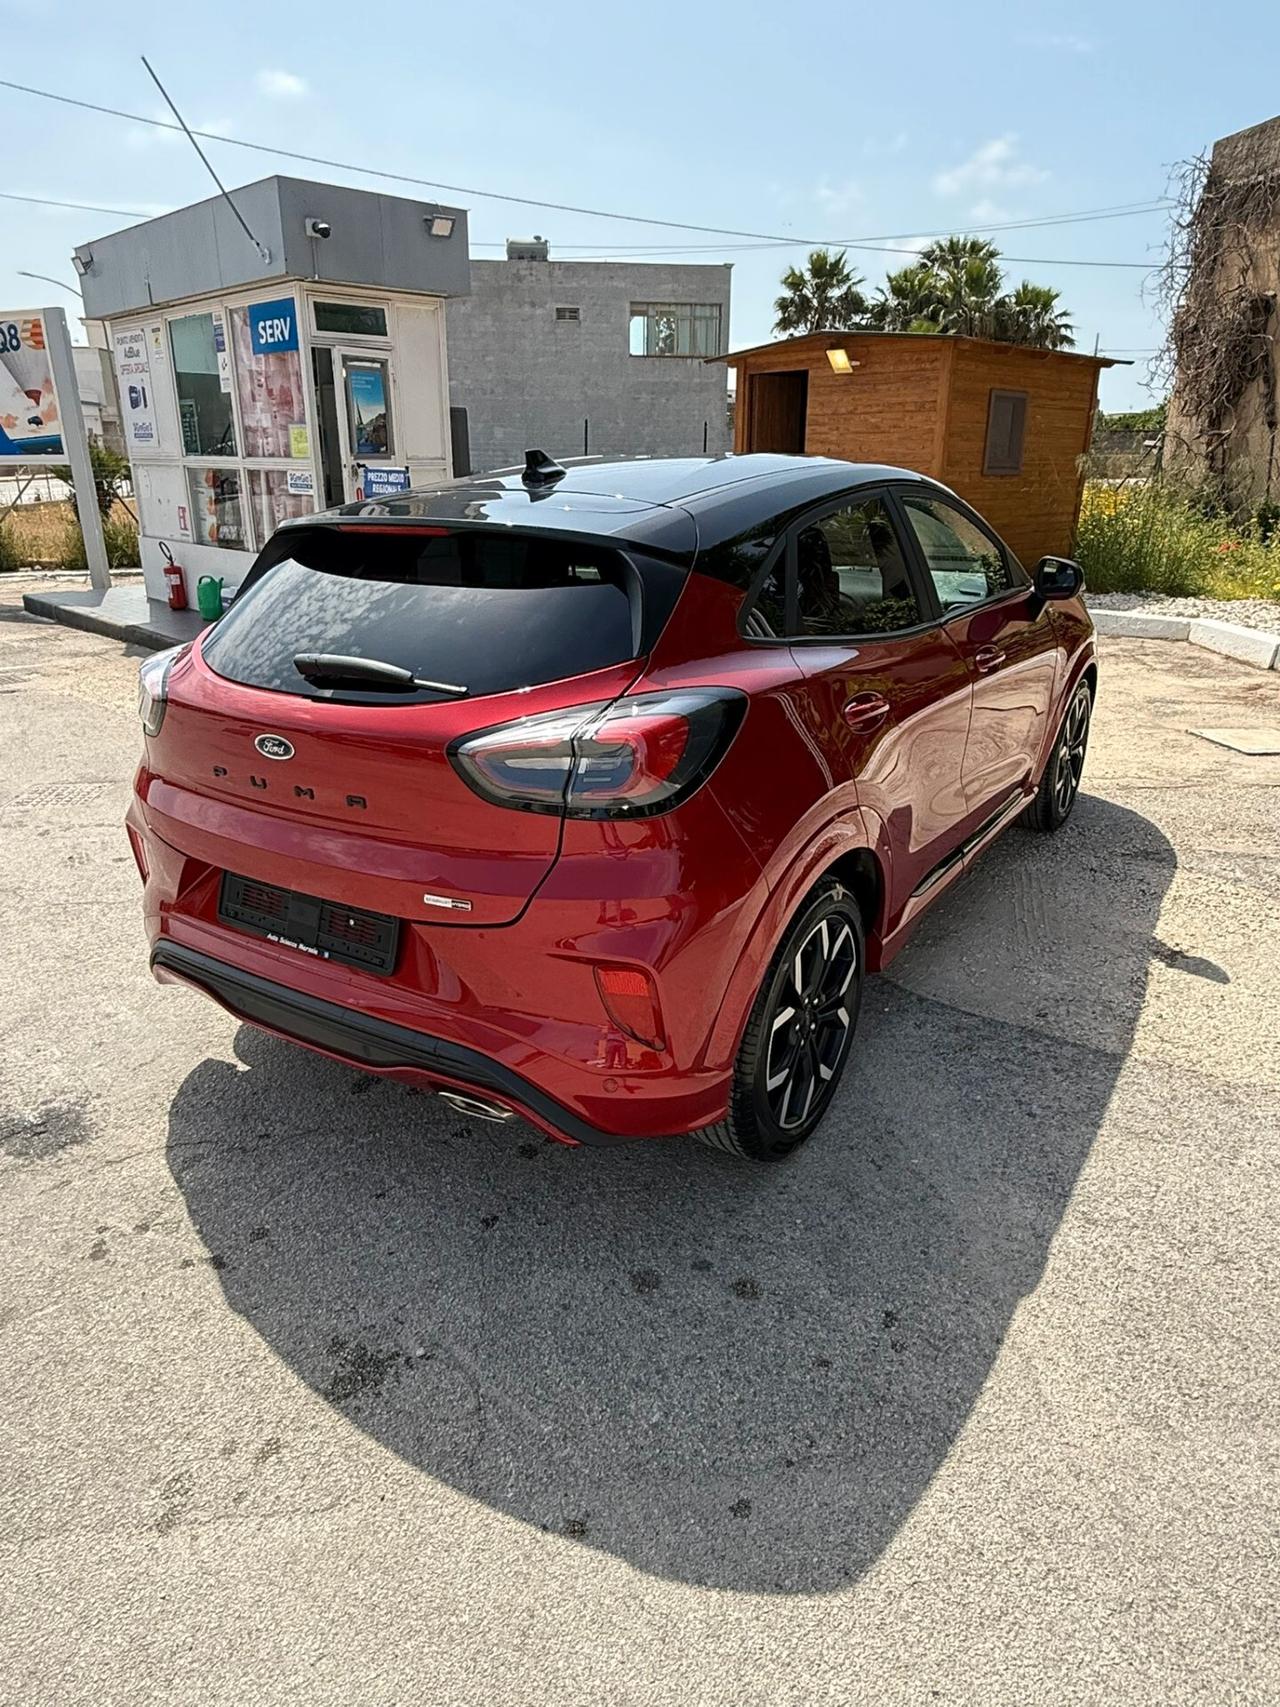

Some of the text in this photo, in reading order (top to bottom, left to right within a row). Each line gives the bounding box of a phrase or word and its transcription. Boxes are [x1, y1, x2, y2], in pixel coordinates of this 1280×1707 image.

[258, 317, 291, 345] SERV
[367, 472, 387, 482] PREZZO
[213, 766, 367, 810] PUMA
